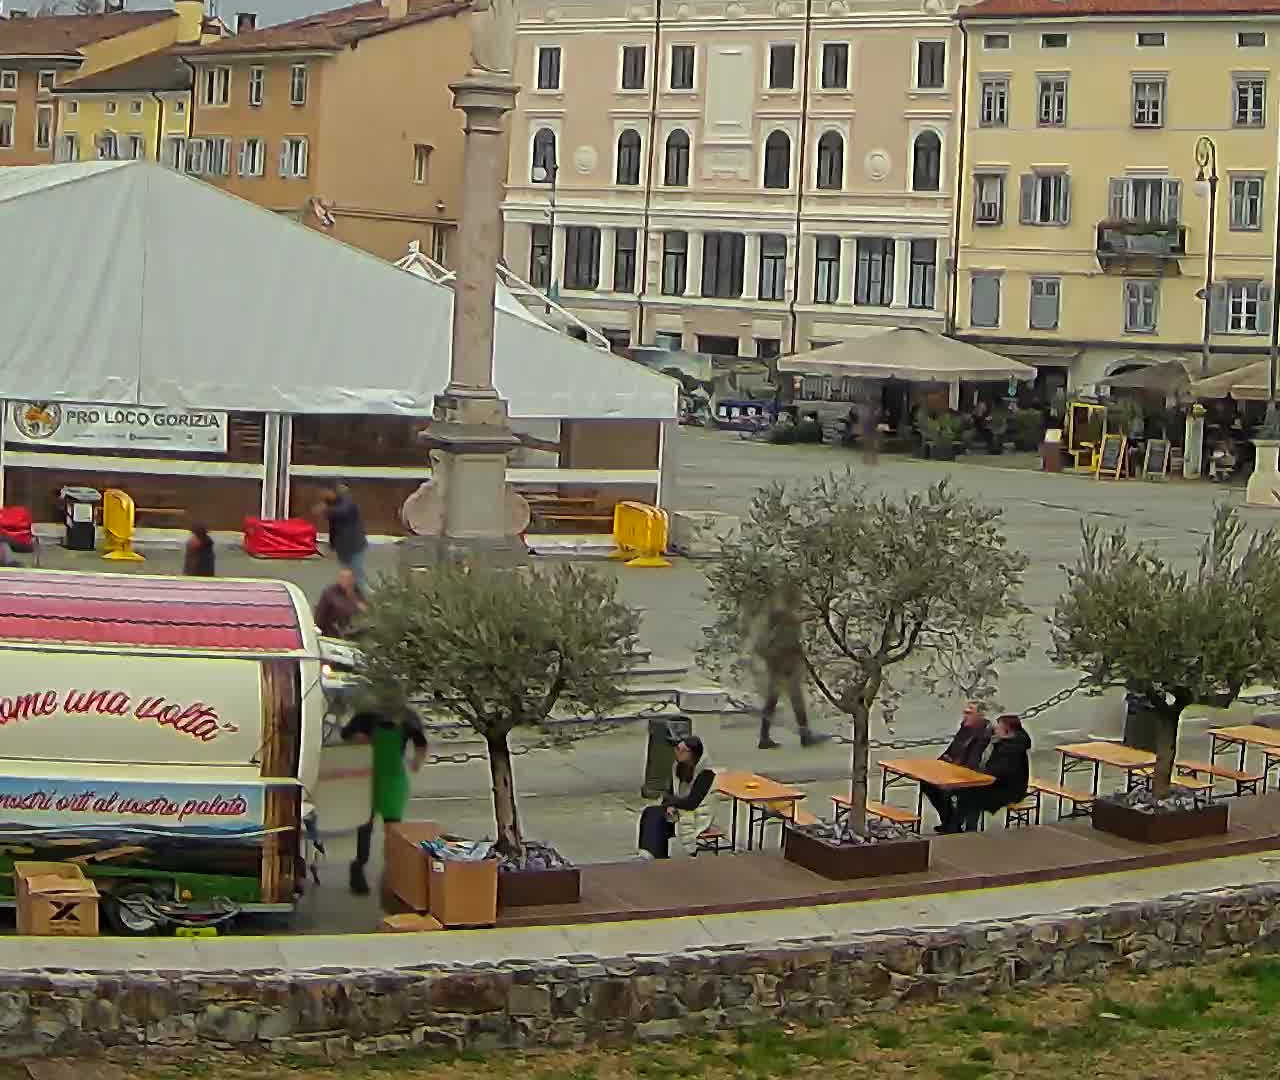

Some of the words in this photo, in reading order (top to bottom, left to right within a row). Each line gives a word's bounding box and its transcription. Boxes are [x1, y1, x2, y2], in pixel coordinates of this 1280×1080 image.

[66, 408, 100, 424] PRO
[104, 410, 149, 426] LOCO
[153, 413, 220, 428] GORIZIA
[63, 689, 131, 714] una
[55, 789, 94, 812] orti
[93, 791, 118, 813] al
[118, 795, 178, 816] vostro
[177, 793, 248, 822] palato
